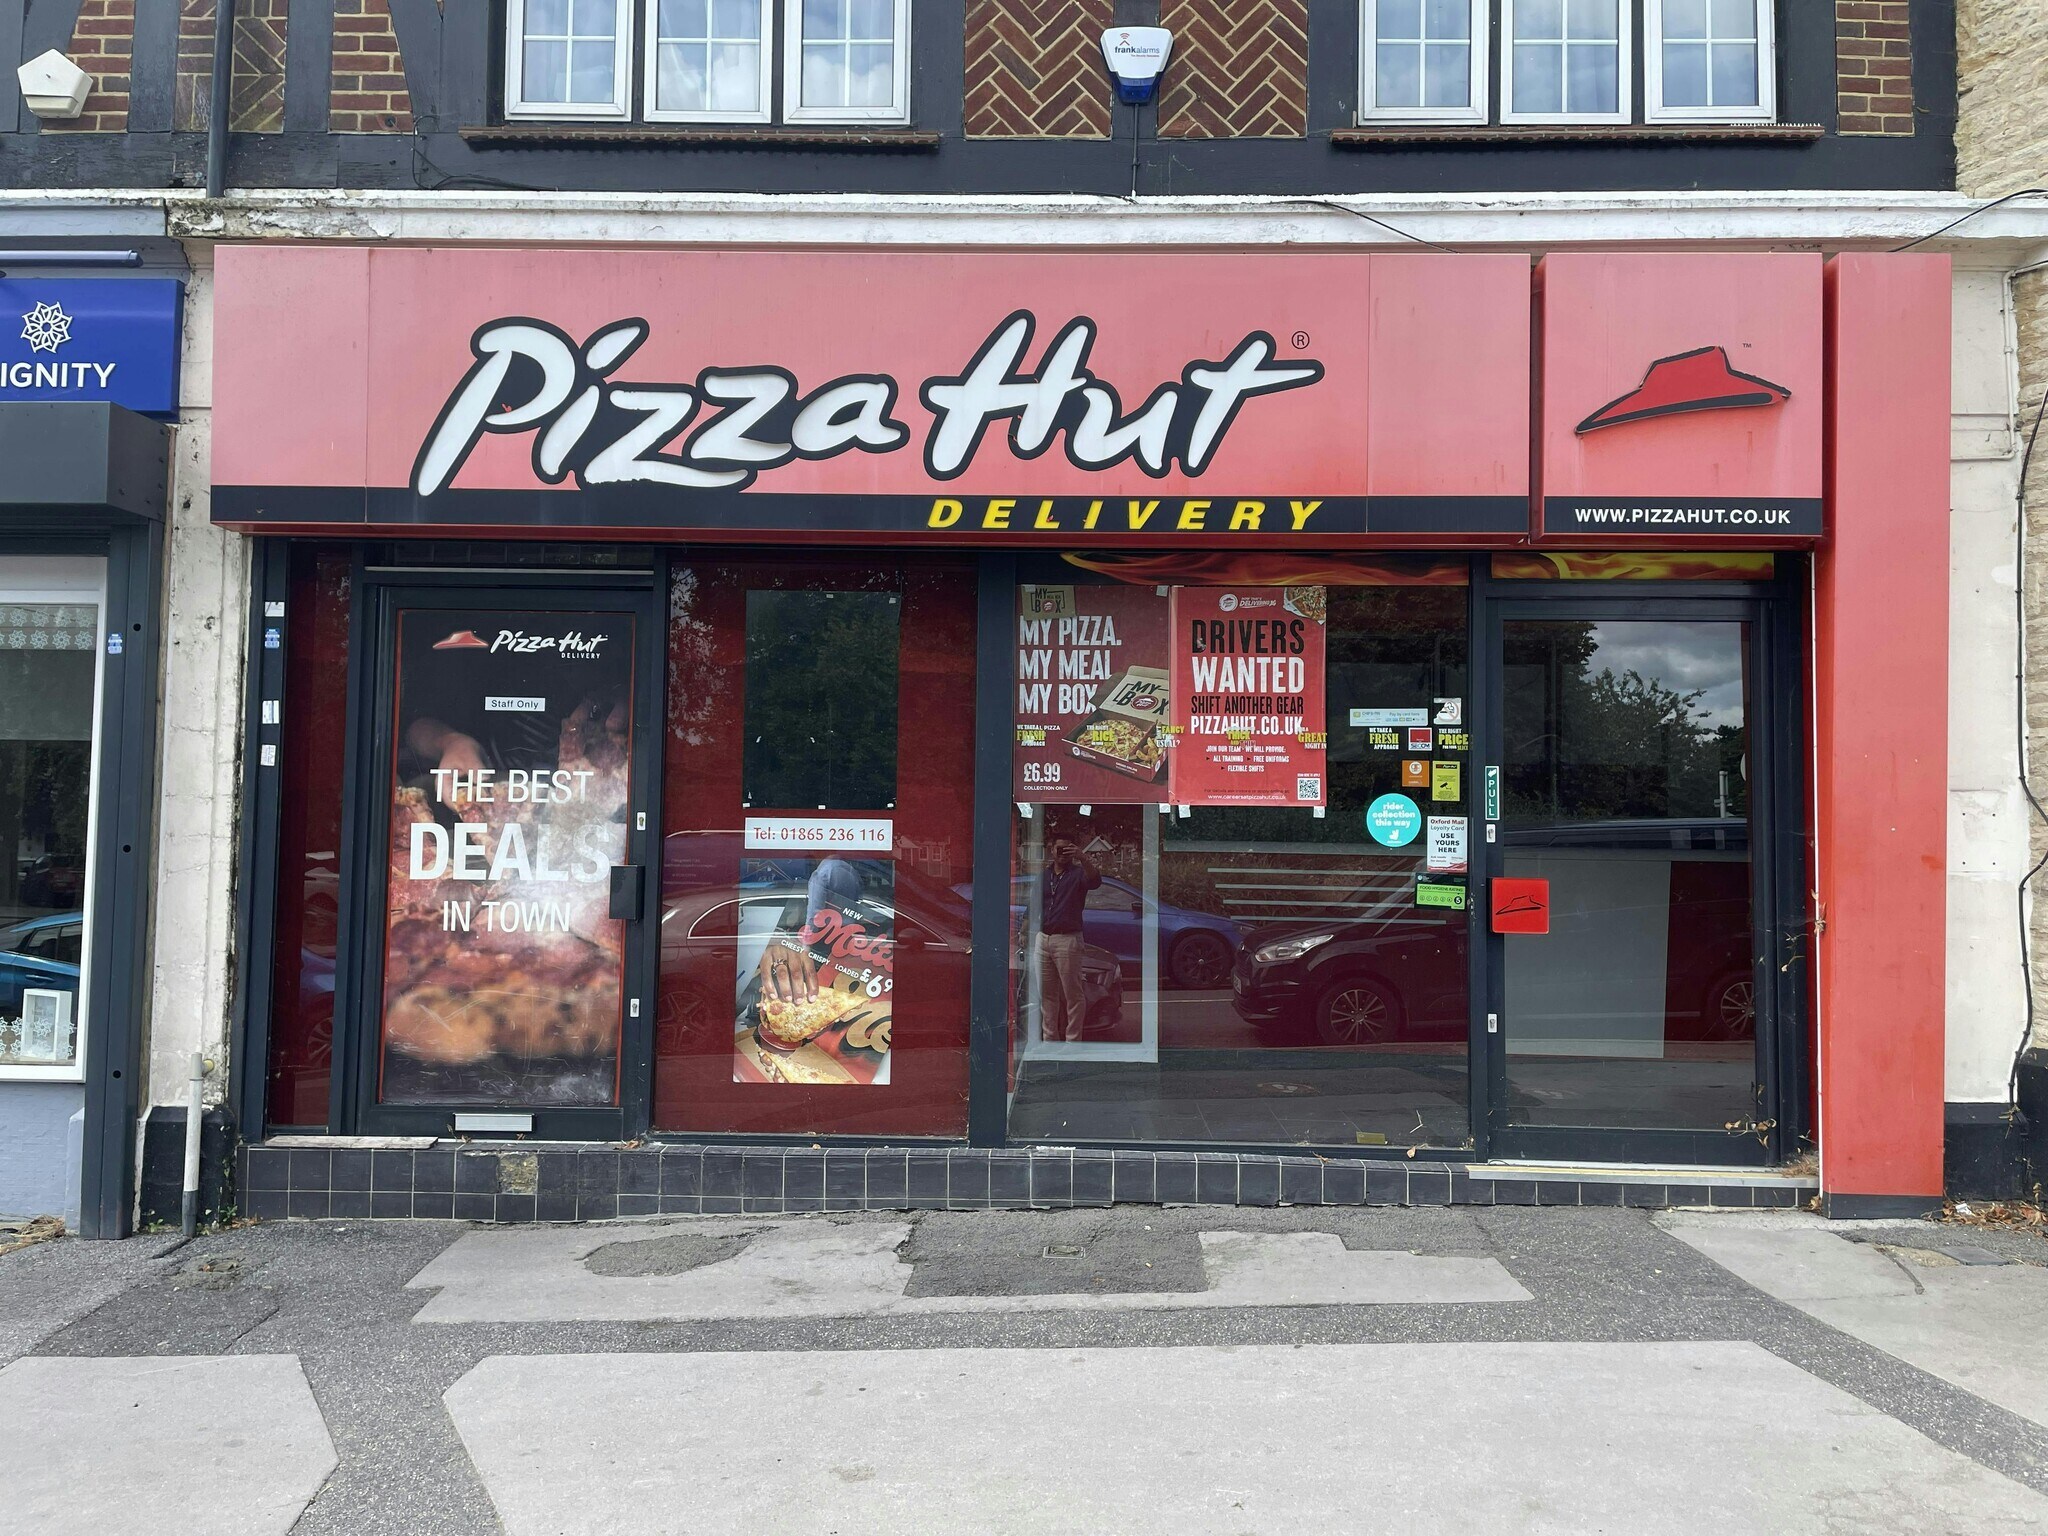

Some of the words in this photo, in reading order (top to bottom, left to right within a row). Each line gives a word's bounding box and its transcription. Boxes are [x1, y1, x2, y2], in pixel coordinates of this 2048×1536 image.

[0, 362, 116, 388] IGNITY
[410, 317, 910, 497] Pizza
[919, 309, 1325, 481] Hut
[926, 499, 1323, 530] DELIVERY
[1574, 507, 1791, 526] WWW.PIZZAHUT.CO.UK
[490, 630, 556, 654] Pizza
[558, 631, 608, 653] Hut
[1020, 616, 1052, 646] MY
[1058, 616, 1122, 646] PIZZA.
[1192, 619, 1304, 654] DRIVERS
[1020, 650, 1052, 680] MY
[1192, 656, 1304, 693] WANTED
[491, 700, 514, 709] Staff
[516, 700, 539, 710] Only
[1019, 684, 1052, 714] MY
[1058, 684, 1098, 714] BOX
[1191, 695, 1220, 714] SHIFT
[1224, 695, 1272, 714] ANOTHER
[1277, 696, 1304, 714] GEAR
[1190, 716, 1304, 734] PIZZAHUT.CO.UK
[1298, 732, 1327, 743] GREAT
[1370, 733, 1399, 744] FRESH
[1438, 734, 1468, 745] PRICE
[1023, 763, 1060, 782] £6.99
[430, 769, 496, 802] THE
[508, 770, 594, 804] BEST
[753, 827, 776, 840] Tel:
[780, 828, 824, 841] 01865
[828, 828, 854, 841] 236
[860, 829, 884, 842] 116
[1394, 820, 1410, 828] way
[409, 822, 611, 884] DEALS
[442, 900, 470, 931] IN
[482, 901, 571, 932] TOWN
[842, 906, 863, 920] NEW
[781, 938, 805, 954] CHEESY
[808, 950, 830, 966] CRISPY
[835, 964, 860, 979] LOADED
